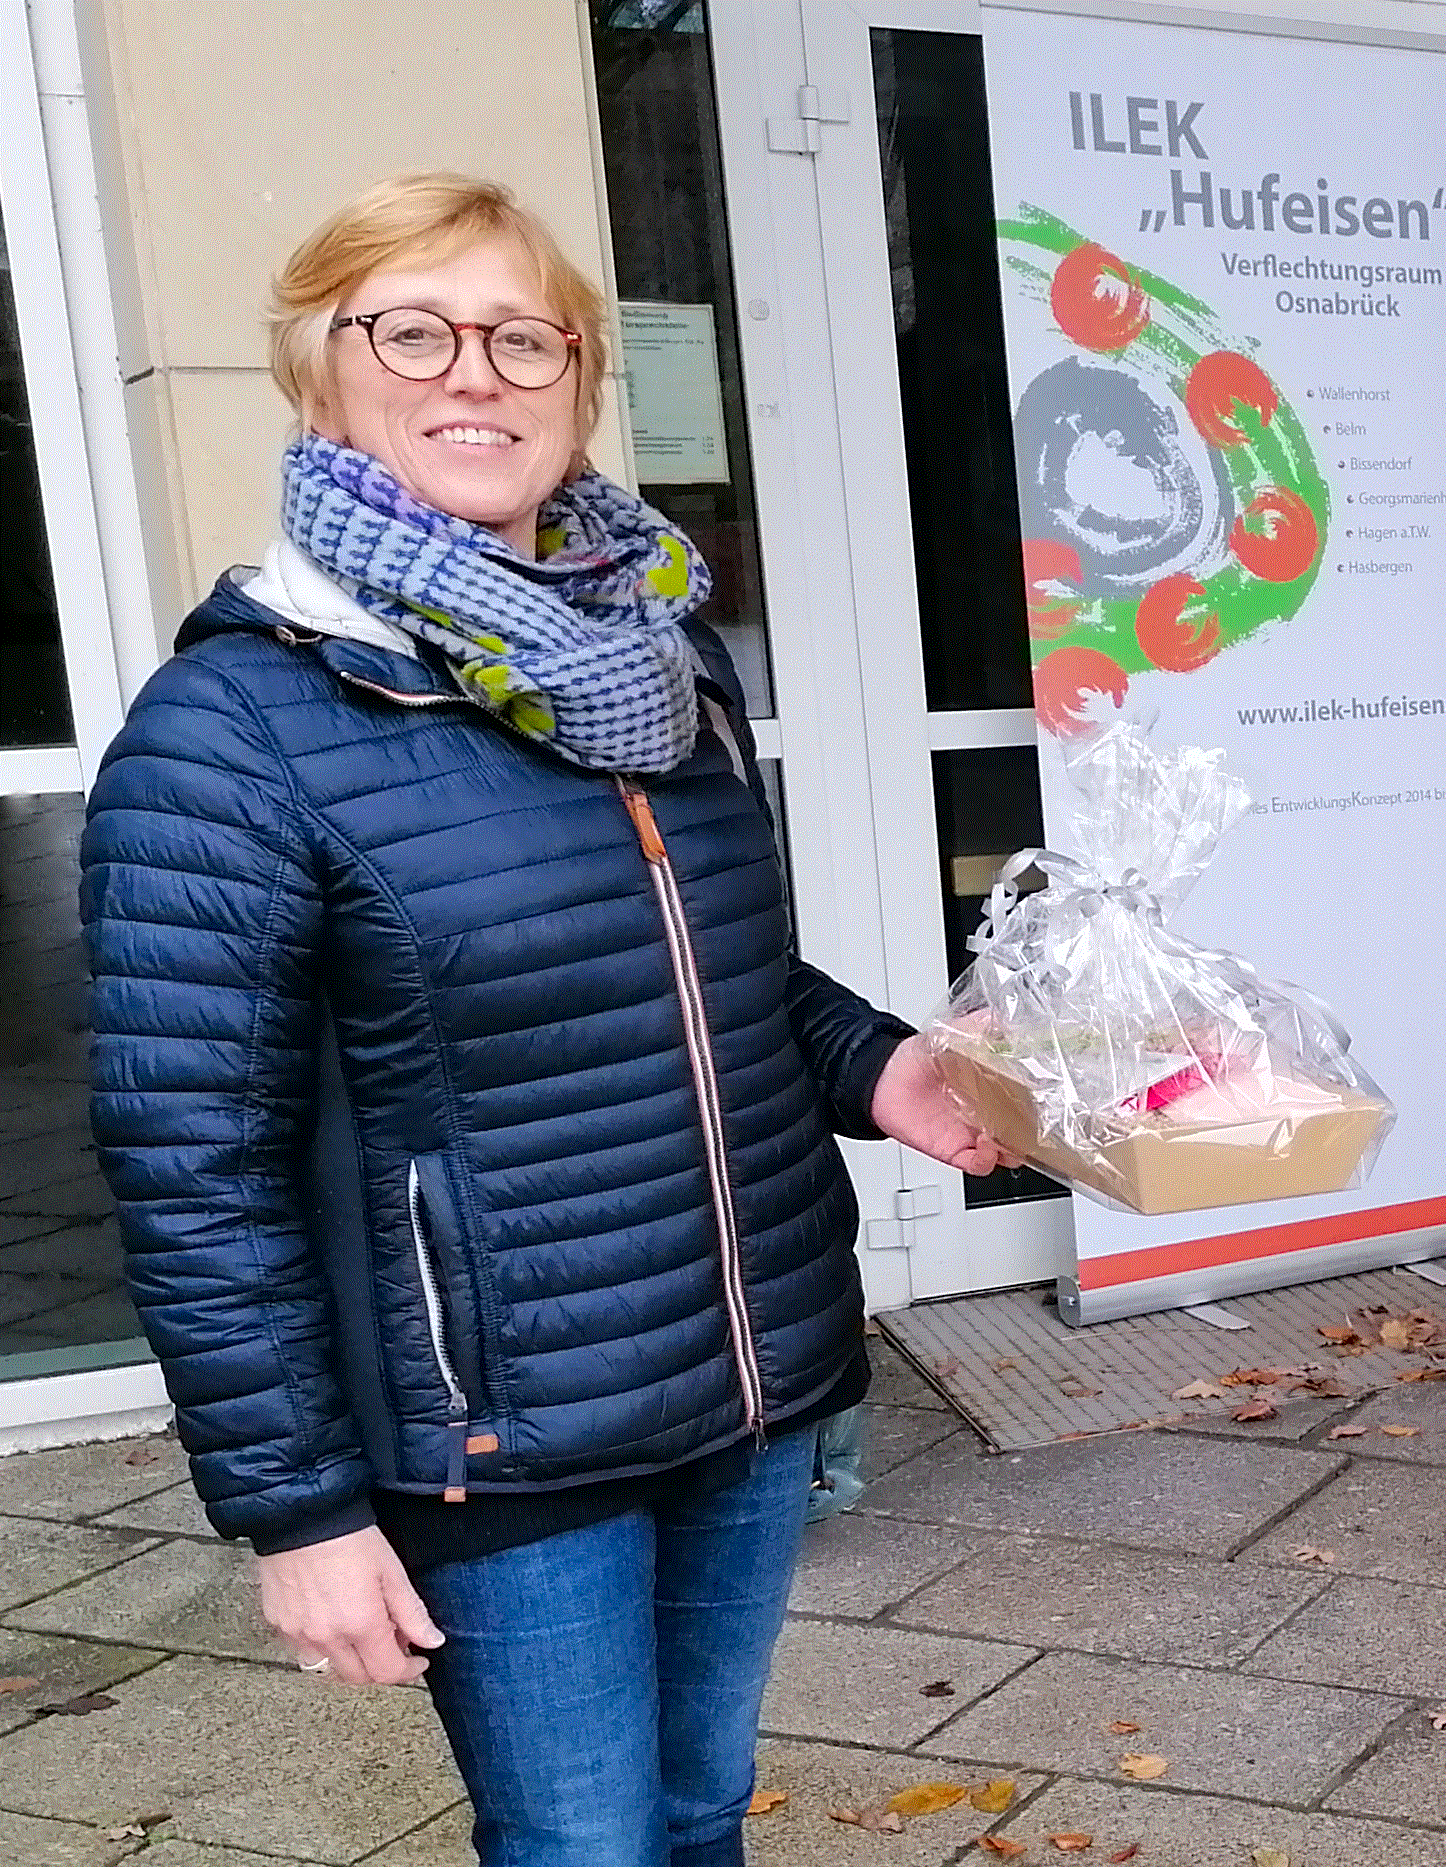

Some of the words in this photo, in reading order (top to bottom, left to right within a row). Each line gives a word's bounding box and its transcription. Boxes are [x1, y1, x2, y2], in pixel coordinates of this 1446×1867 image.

[1068, 90, 1209, 160] ILEK
[1221, 252, 1443, 287] Verflechtungsraum
[1275, 290, 1400, 317] Osnabrück
[1318, 386, 1391, 402] Wallenhorst
[1335, 421, 1367, 436] Belm
[1350, 456, 1413, 471] Bissendorf
[1358, 525, 1397, 543] Hagen
[1349, 559, 1413, 576] Hasbergen
[1271, 791, 1402, 813] EntwicklungsKonzept
[1405, 789, 1431, 803] 2014
